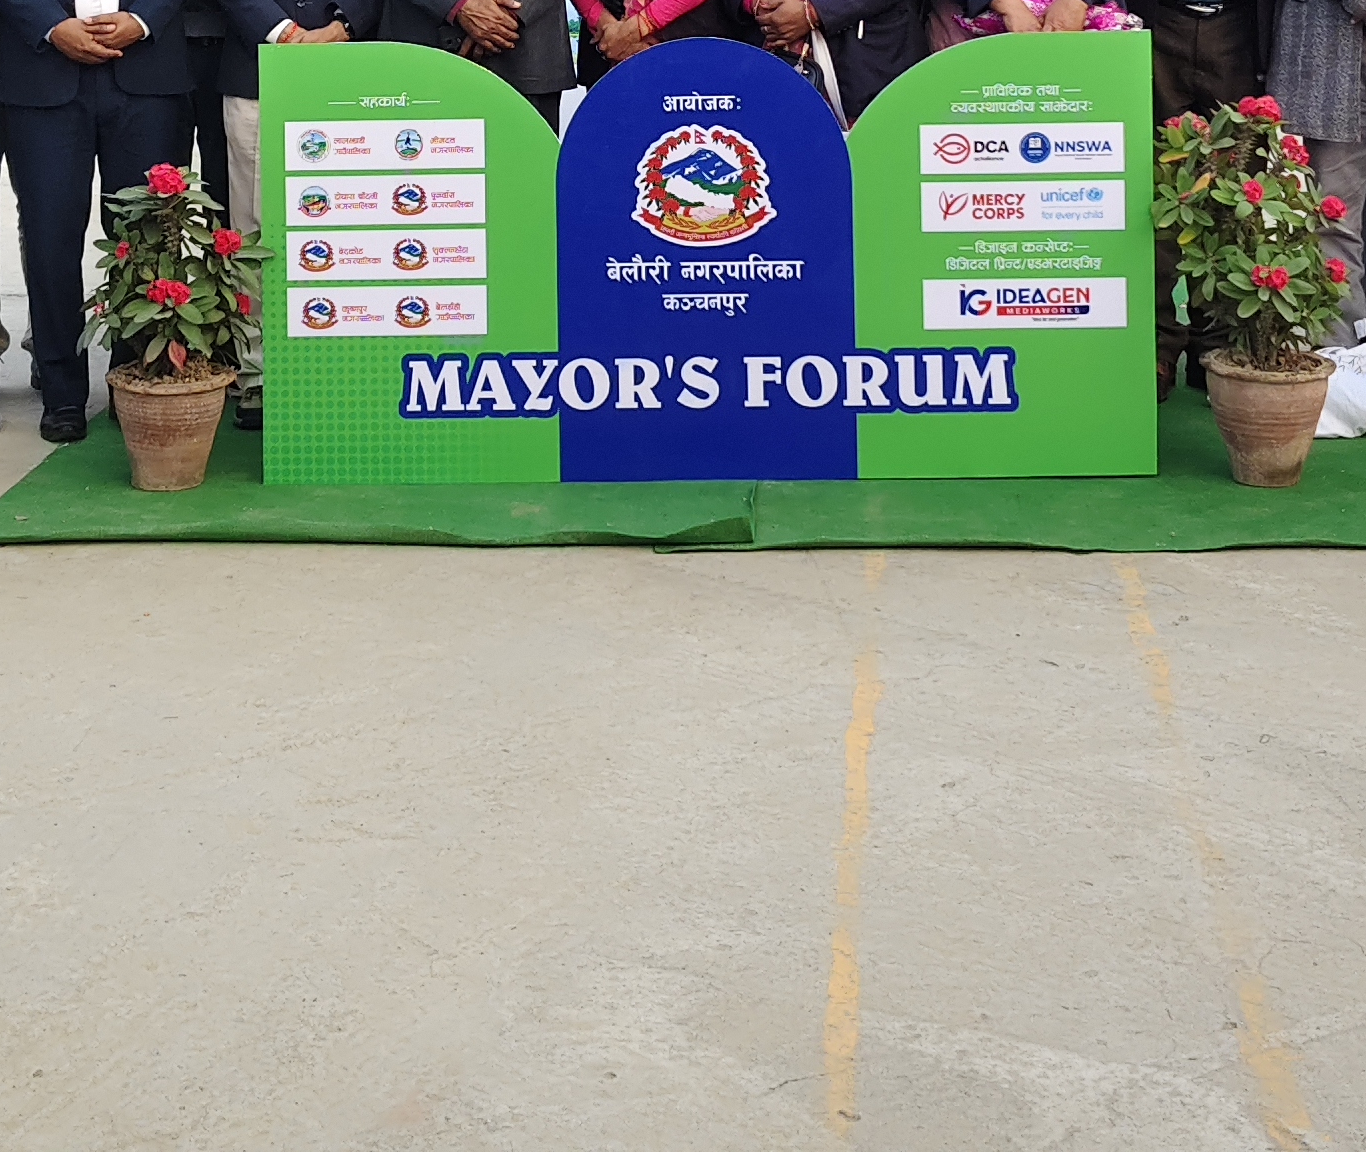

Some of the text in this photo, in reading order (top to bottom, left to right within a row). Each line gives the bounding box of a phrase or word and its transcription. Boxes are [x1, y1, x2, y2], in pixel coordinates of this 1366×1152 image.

[973, 140, 1113, 154] DCA NNSWA
[972, 188, 1085, 207] MERCY unicef
[972, 207, 1104, 221] CORPS for every child
[974, 240, 1018, 254] डिजाइन
[606, 254, 805, 285] बेलौरी नगरपालिका
[945, 256, 990, 270] डिजिटल
[996, 288, 1090, 304] IDEAGEN
[661, 292, 749, 317] कञ्चनपुर
[1005, 307, 1080, 315] MEDIAWORKS
[407, 353, 1012, 412] MAYOR'S FORUM
